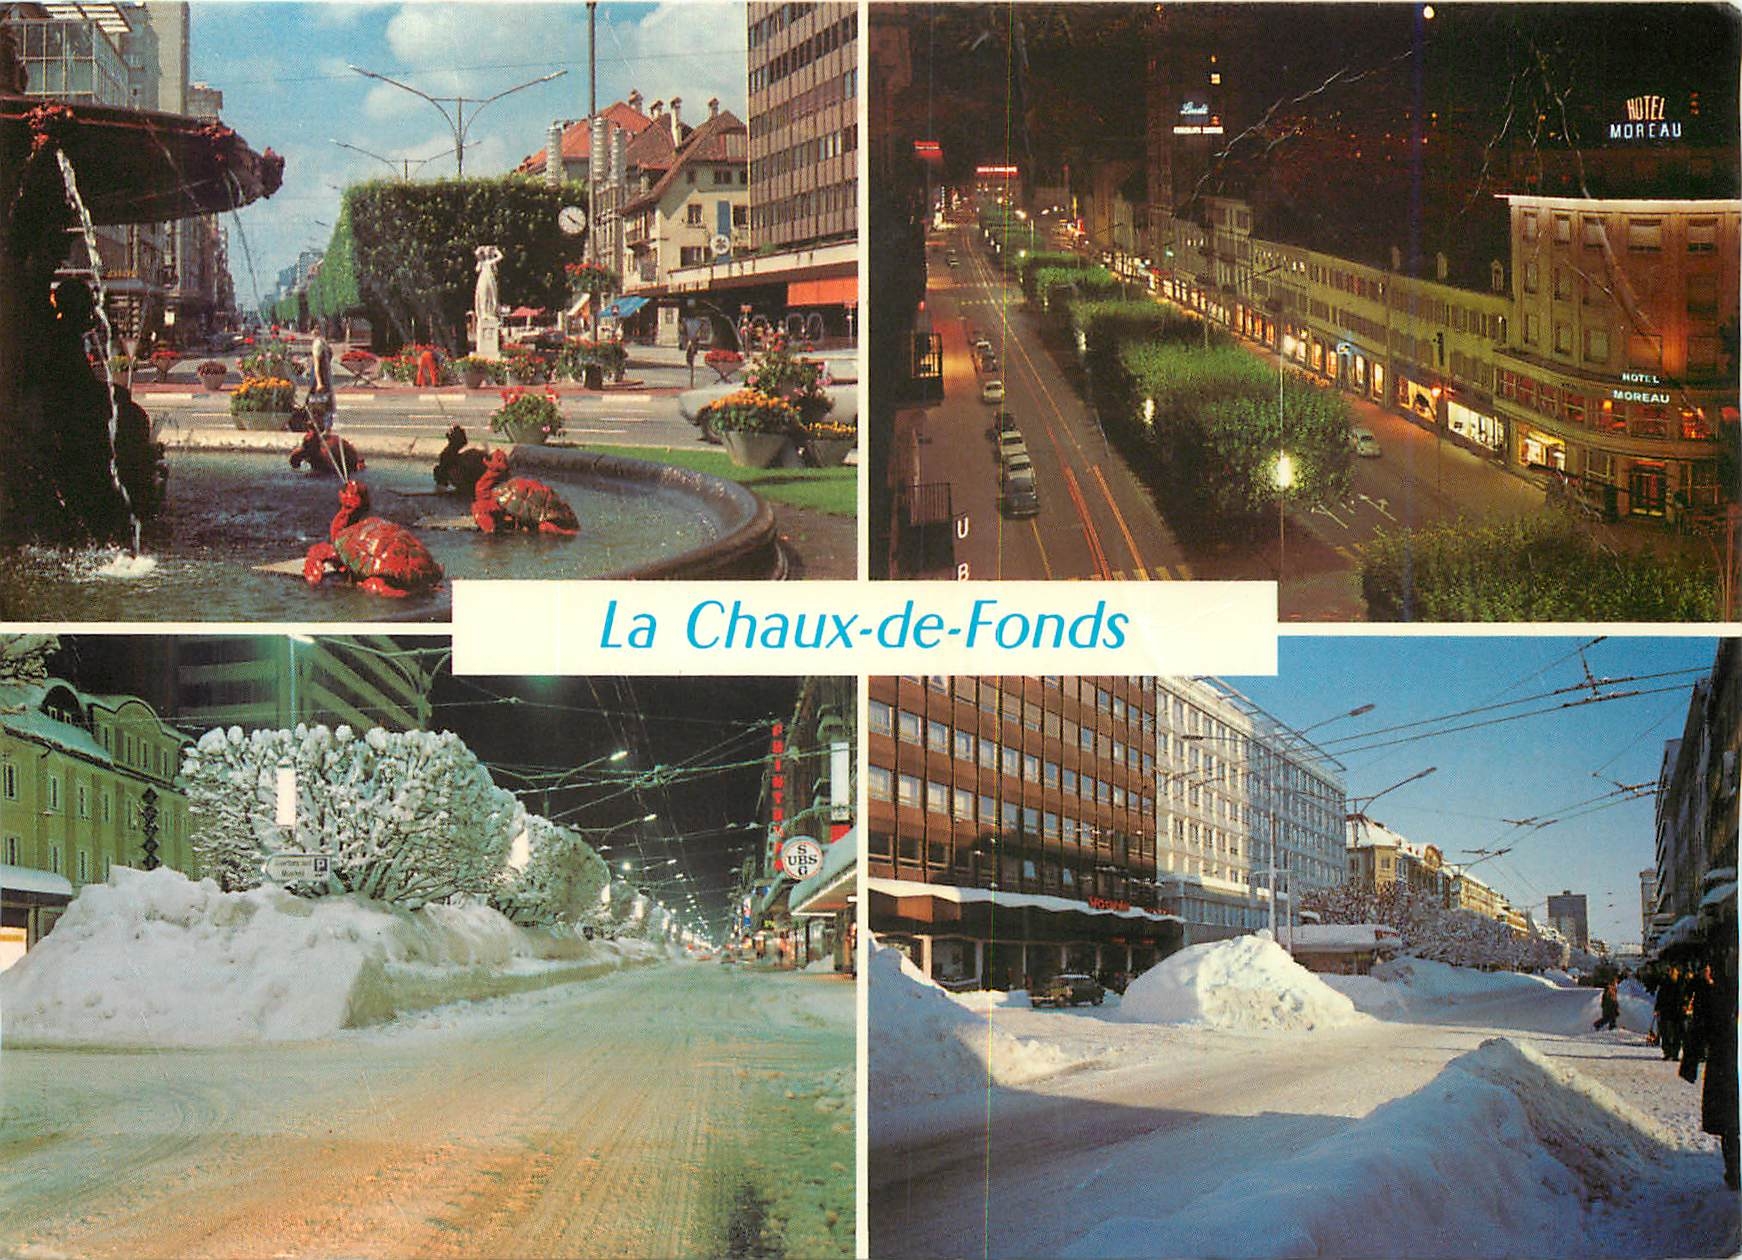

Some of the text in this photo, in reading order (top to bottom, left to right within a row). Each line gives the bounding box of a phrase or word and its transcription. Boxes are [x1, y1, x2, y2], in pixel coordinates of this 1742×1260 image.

[1627, 95, 1665, 120] HOTEL
[1610, 123, 1682, 138] MOREAU
[1622, 373, 1660, 384] HOTEL
[1612, 390, 1670, 404] MOREAU
